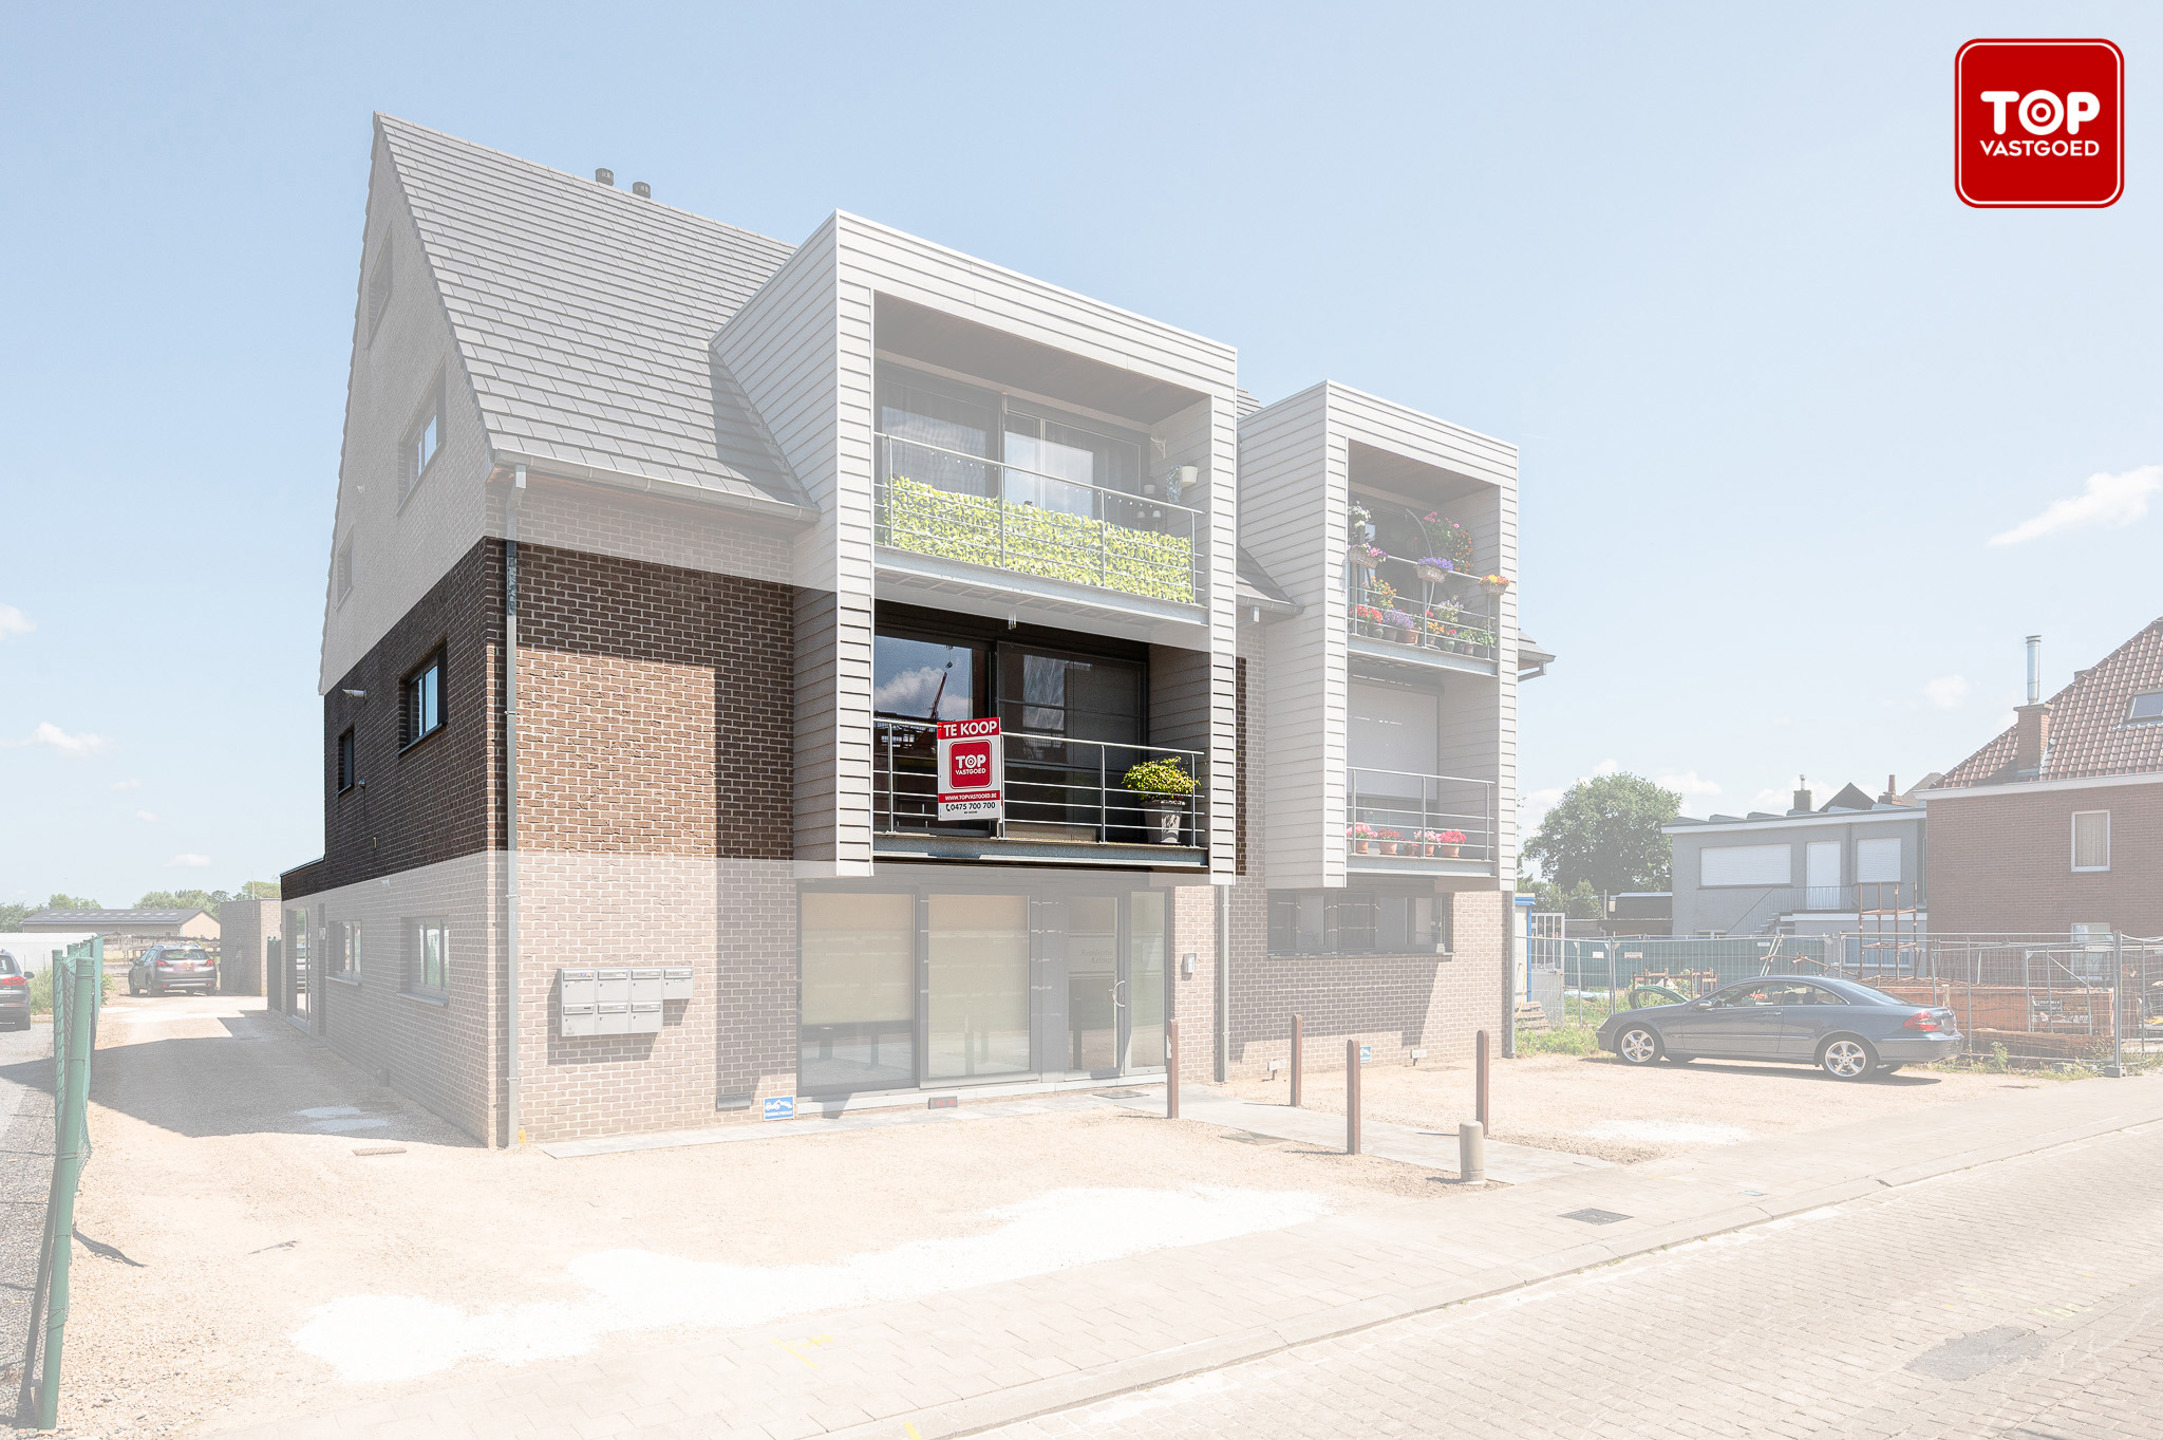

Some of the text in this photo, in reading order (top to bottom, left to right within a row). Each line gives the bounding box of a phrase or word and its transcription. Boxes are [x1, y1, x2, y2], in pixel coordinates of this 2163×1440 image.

[943, 720, 998, 737] TE KOOP
[955, 754, 987, 769] TOP
[955, 767, 987, 775] VASTGOED
[950, 803, 967, 811] 0475
[982, 801, 996, 809] 700
